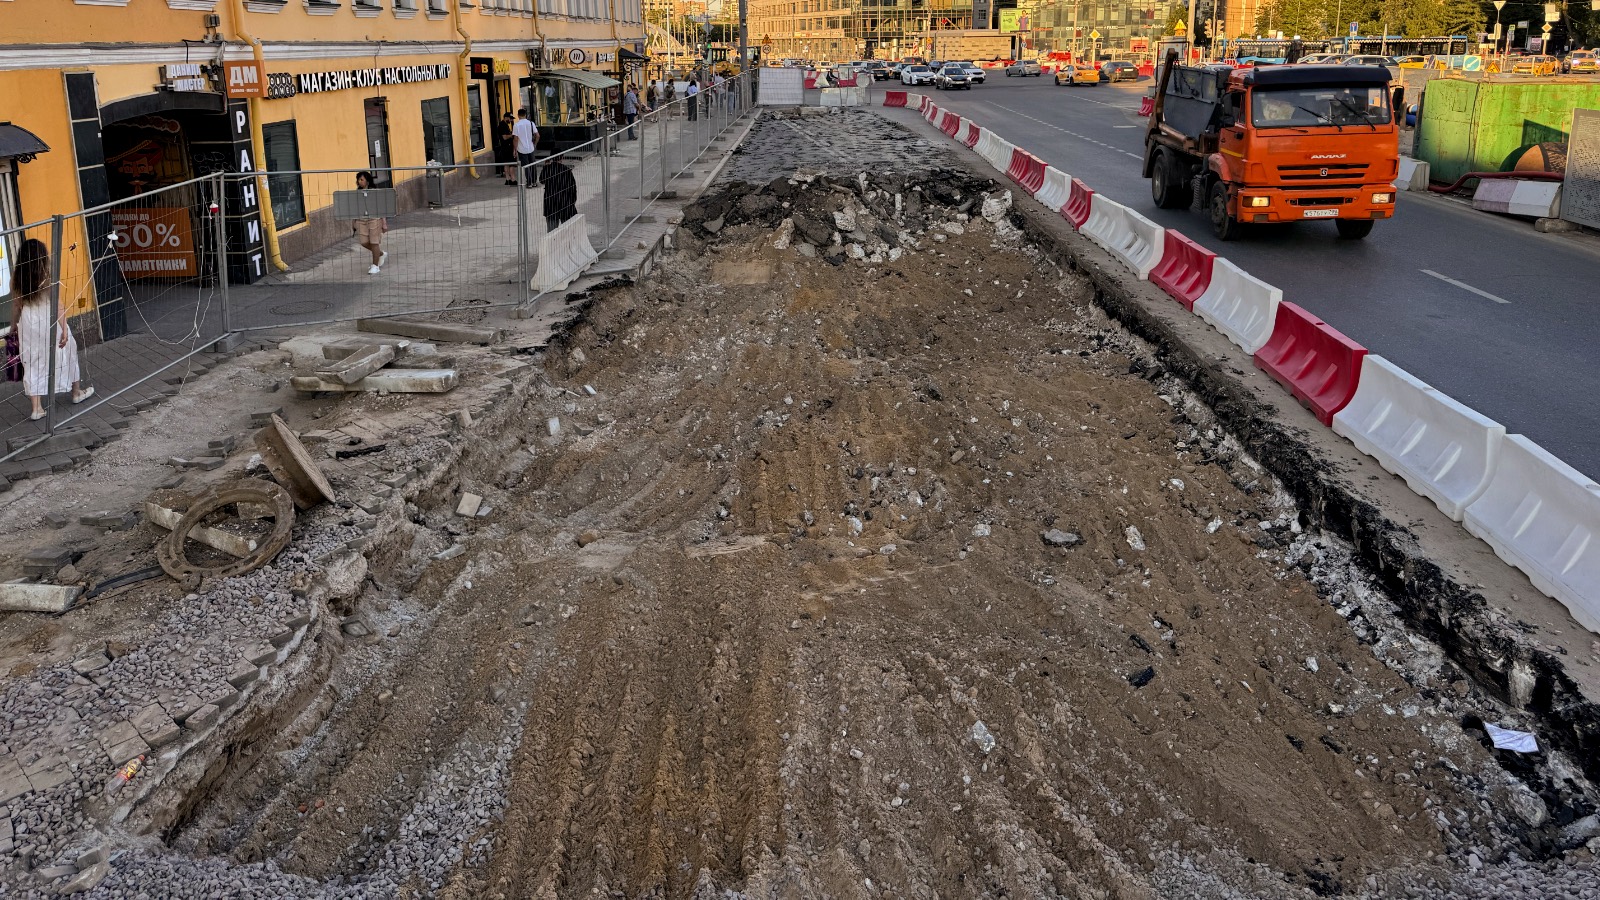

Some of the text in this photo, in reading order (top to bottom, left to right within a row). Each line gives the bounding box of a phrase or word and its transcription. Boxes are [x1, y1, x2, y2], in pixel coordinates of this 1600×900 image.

[175, 77, 206, 92] МАСТЕР
[229, 65, 259, 87] ДМ
[269, 75, 292, 86] OBBY
[300, 63, 452, 94] МАГАЗИН-КЛУБ НАСТОЛЬНЫХ ИГР
[268, 85, 296, 97] GAMES
[235, 110, 263, 277] РАНИТ
[139, 213, 150, 222] ДО
[112, 223, 180, 248] 50%
